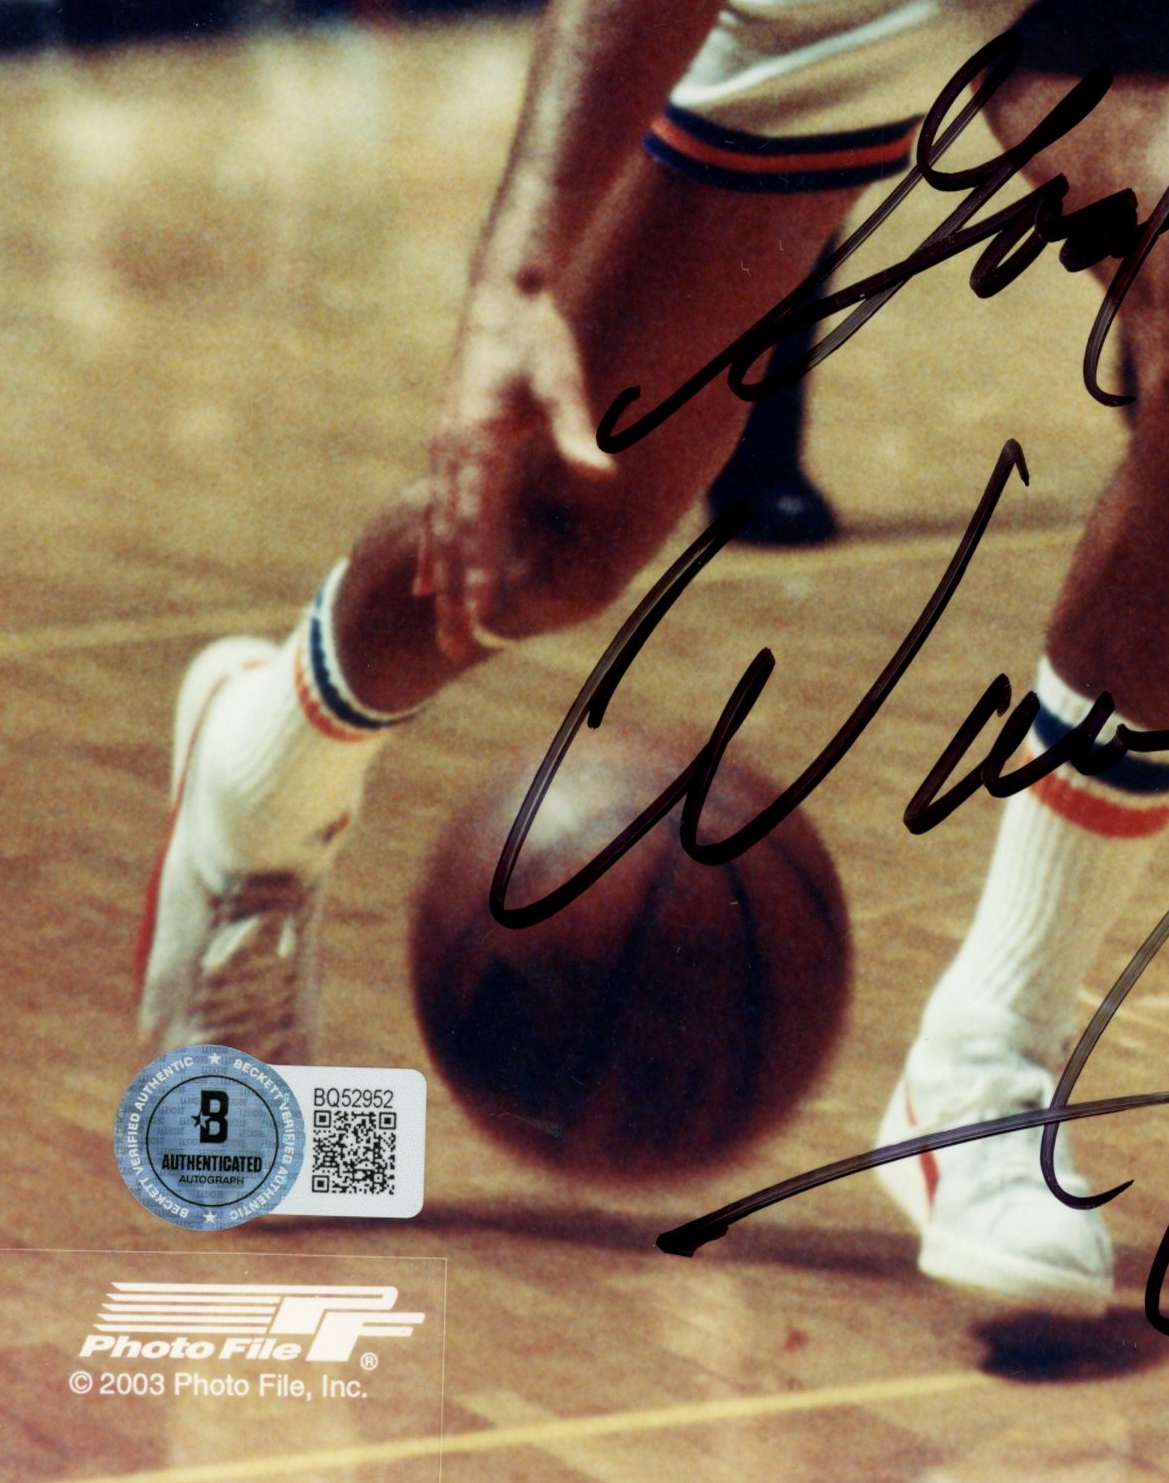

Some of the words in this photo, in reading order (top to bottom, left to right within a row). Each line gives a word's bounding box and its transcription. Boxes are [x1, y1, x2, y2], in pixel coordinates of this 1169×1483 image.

[134, 1056, 194, 1111] AUTHENTIC
[233, 1059, 283, 1101] BECKETT
[314, 1087, 394, 1109] BQ52952
[127, 1114, 143, 1176] VERIFIED
[279, 1102, 295, 1165] VERIFIED
[161, 1154, 263, 1173] AUTHENTICATED
[178, 1175, 245, 1185] AUTOGRAPH
[140, 1178, 190, 1219] BECKETT
[229, 1166, 289, 1221] AUTHENTIC
